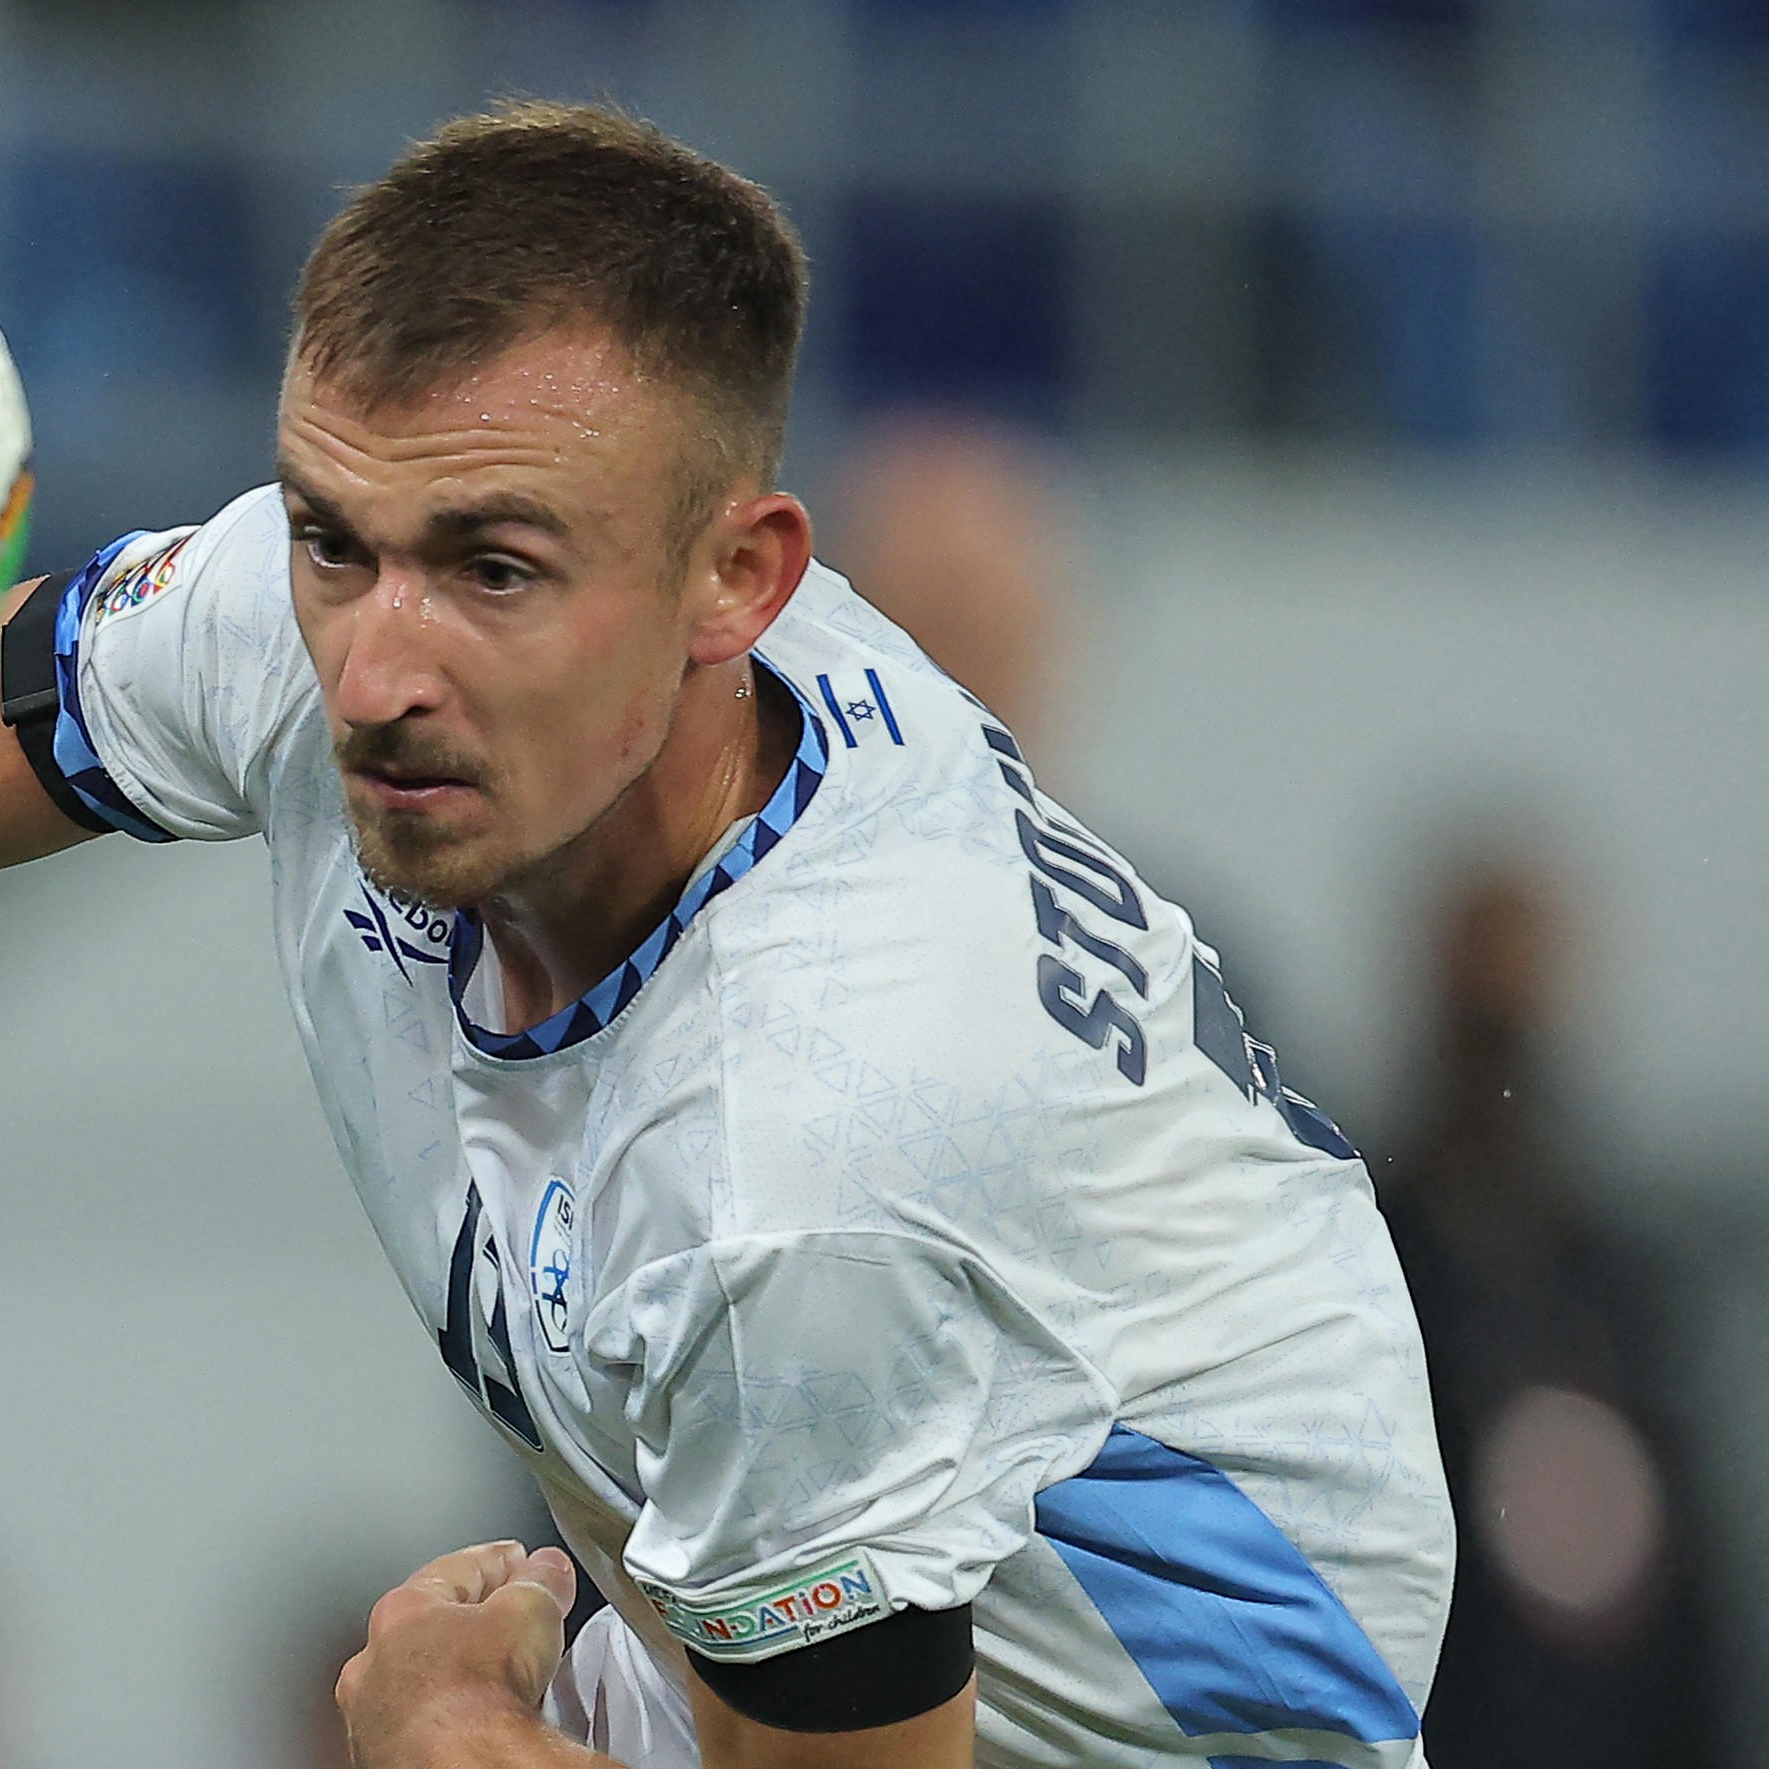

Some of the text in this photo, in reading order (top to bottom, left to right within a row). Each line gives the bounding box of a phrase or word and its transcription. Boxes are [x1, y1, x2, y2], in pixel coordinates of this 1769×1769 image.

[981, 724, 1149, 1087] STO
[652, 1569, 872, 1640] NDATION
[803, 1622, 823, 1642] for
